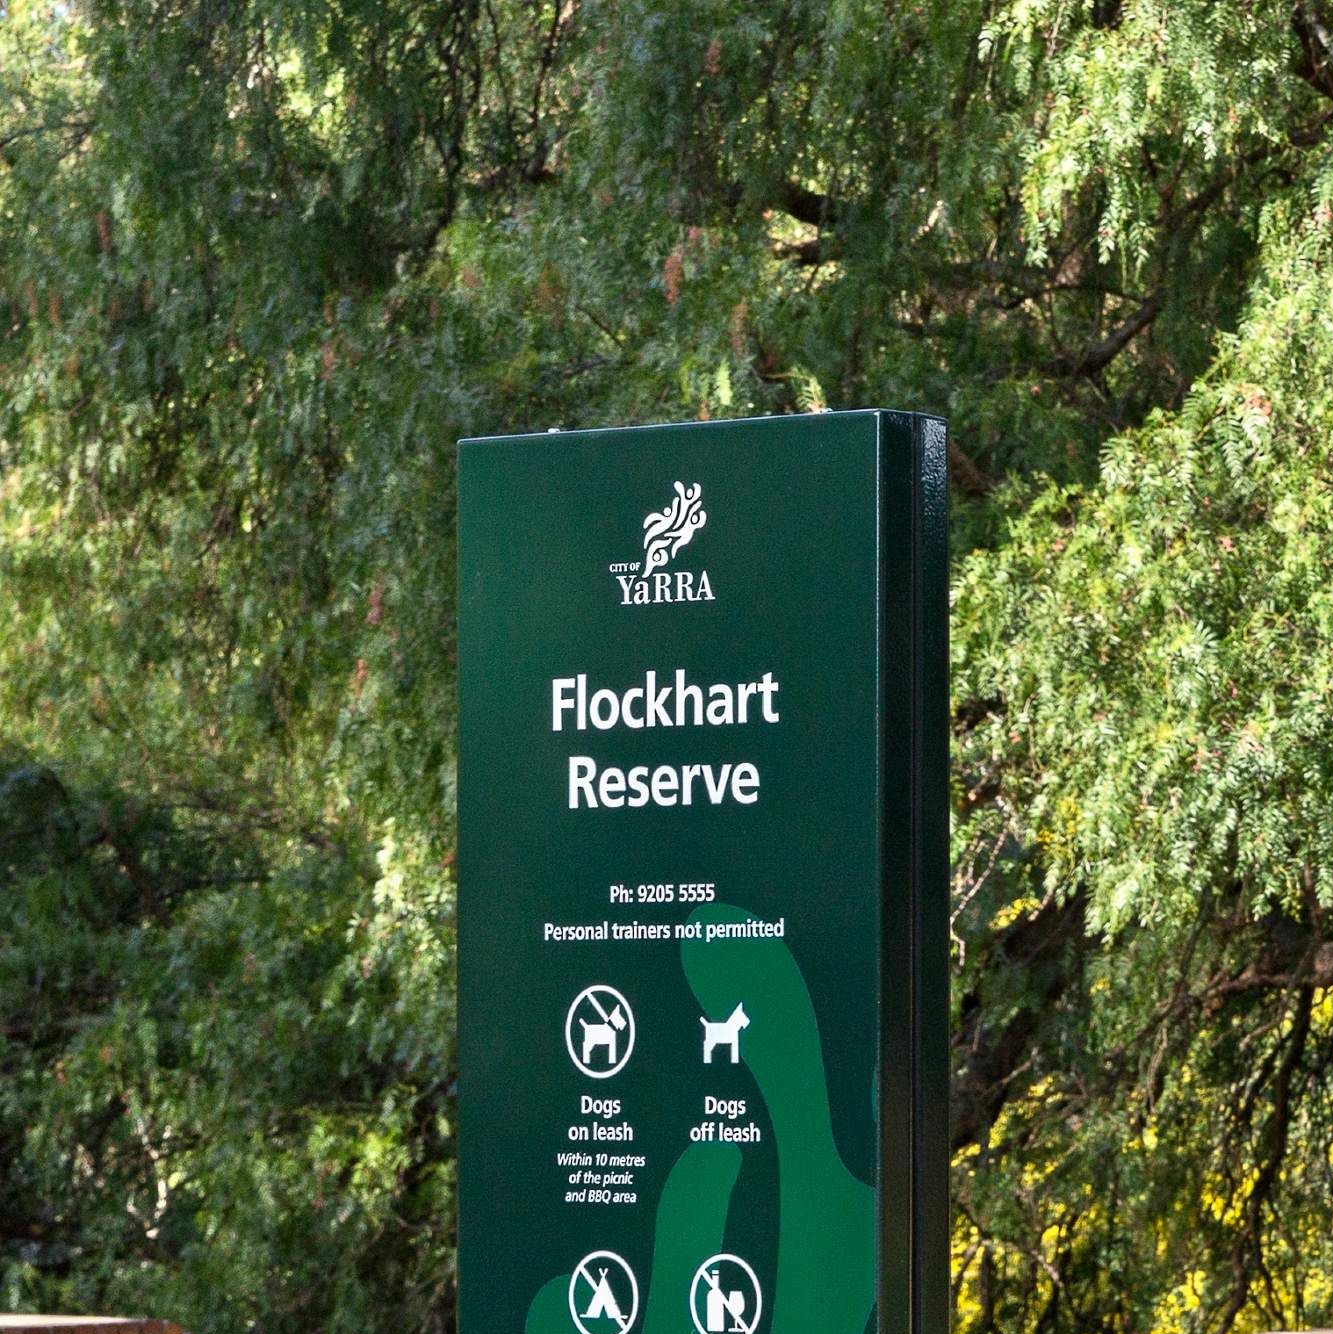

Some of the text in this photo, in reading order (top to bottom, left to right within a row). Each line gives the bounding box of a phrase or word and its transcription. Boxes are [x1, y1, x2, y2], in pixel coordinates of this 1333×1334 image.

[609, 562, 640, 572] CITY OF
[553, 669, 779, 731] Flockhart
[569, 756, 760, 808] Reserve
[610, 884, 714, 902] Ph: 9205 5555
[545, 918, 784, 942] Personal trainers not permitted
[581, 1096, 620, 1118] Dogs
[705, 1096, 745, 1119] Dogs
[568, 1122, 633, 1140] on leash
[690, 1122, 760, 1142] off leash
[558, 1153, 645, 1166] Within 10 metres
[569, 1171, 633, 1187] of the picnic
[565, 1189, 636, 1204] and BBQ area
